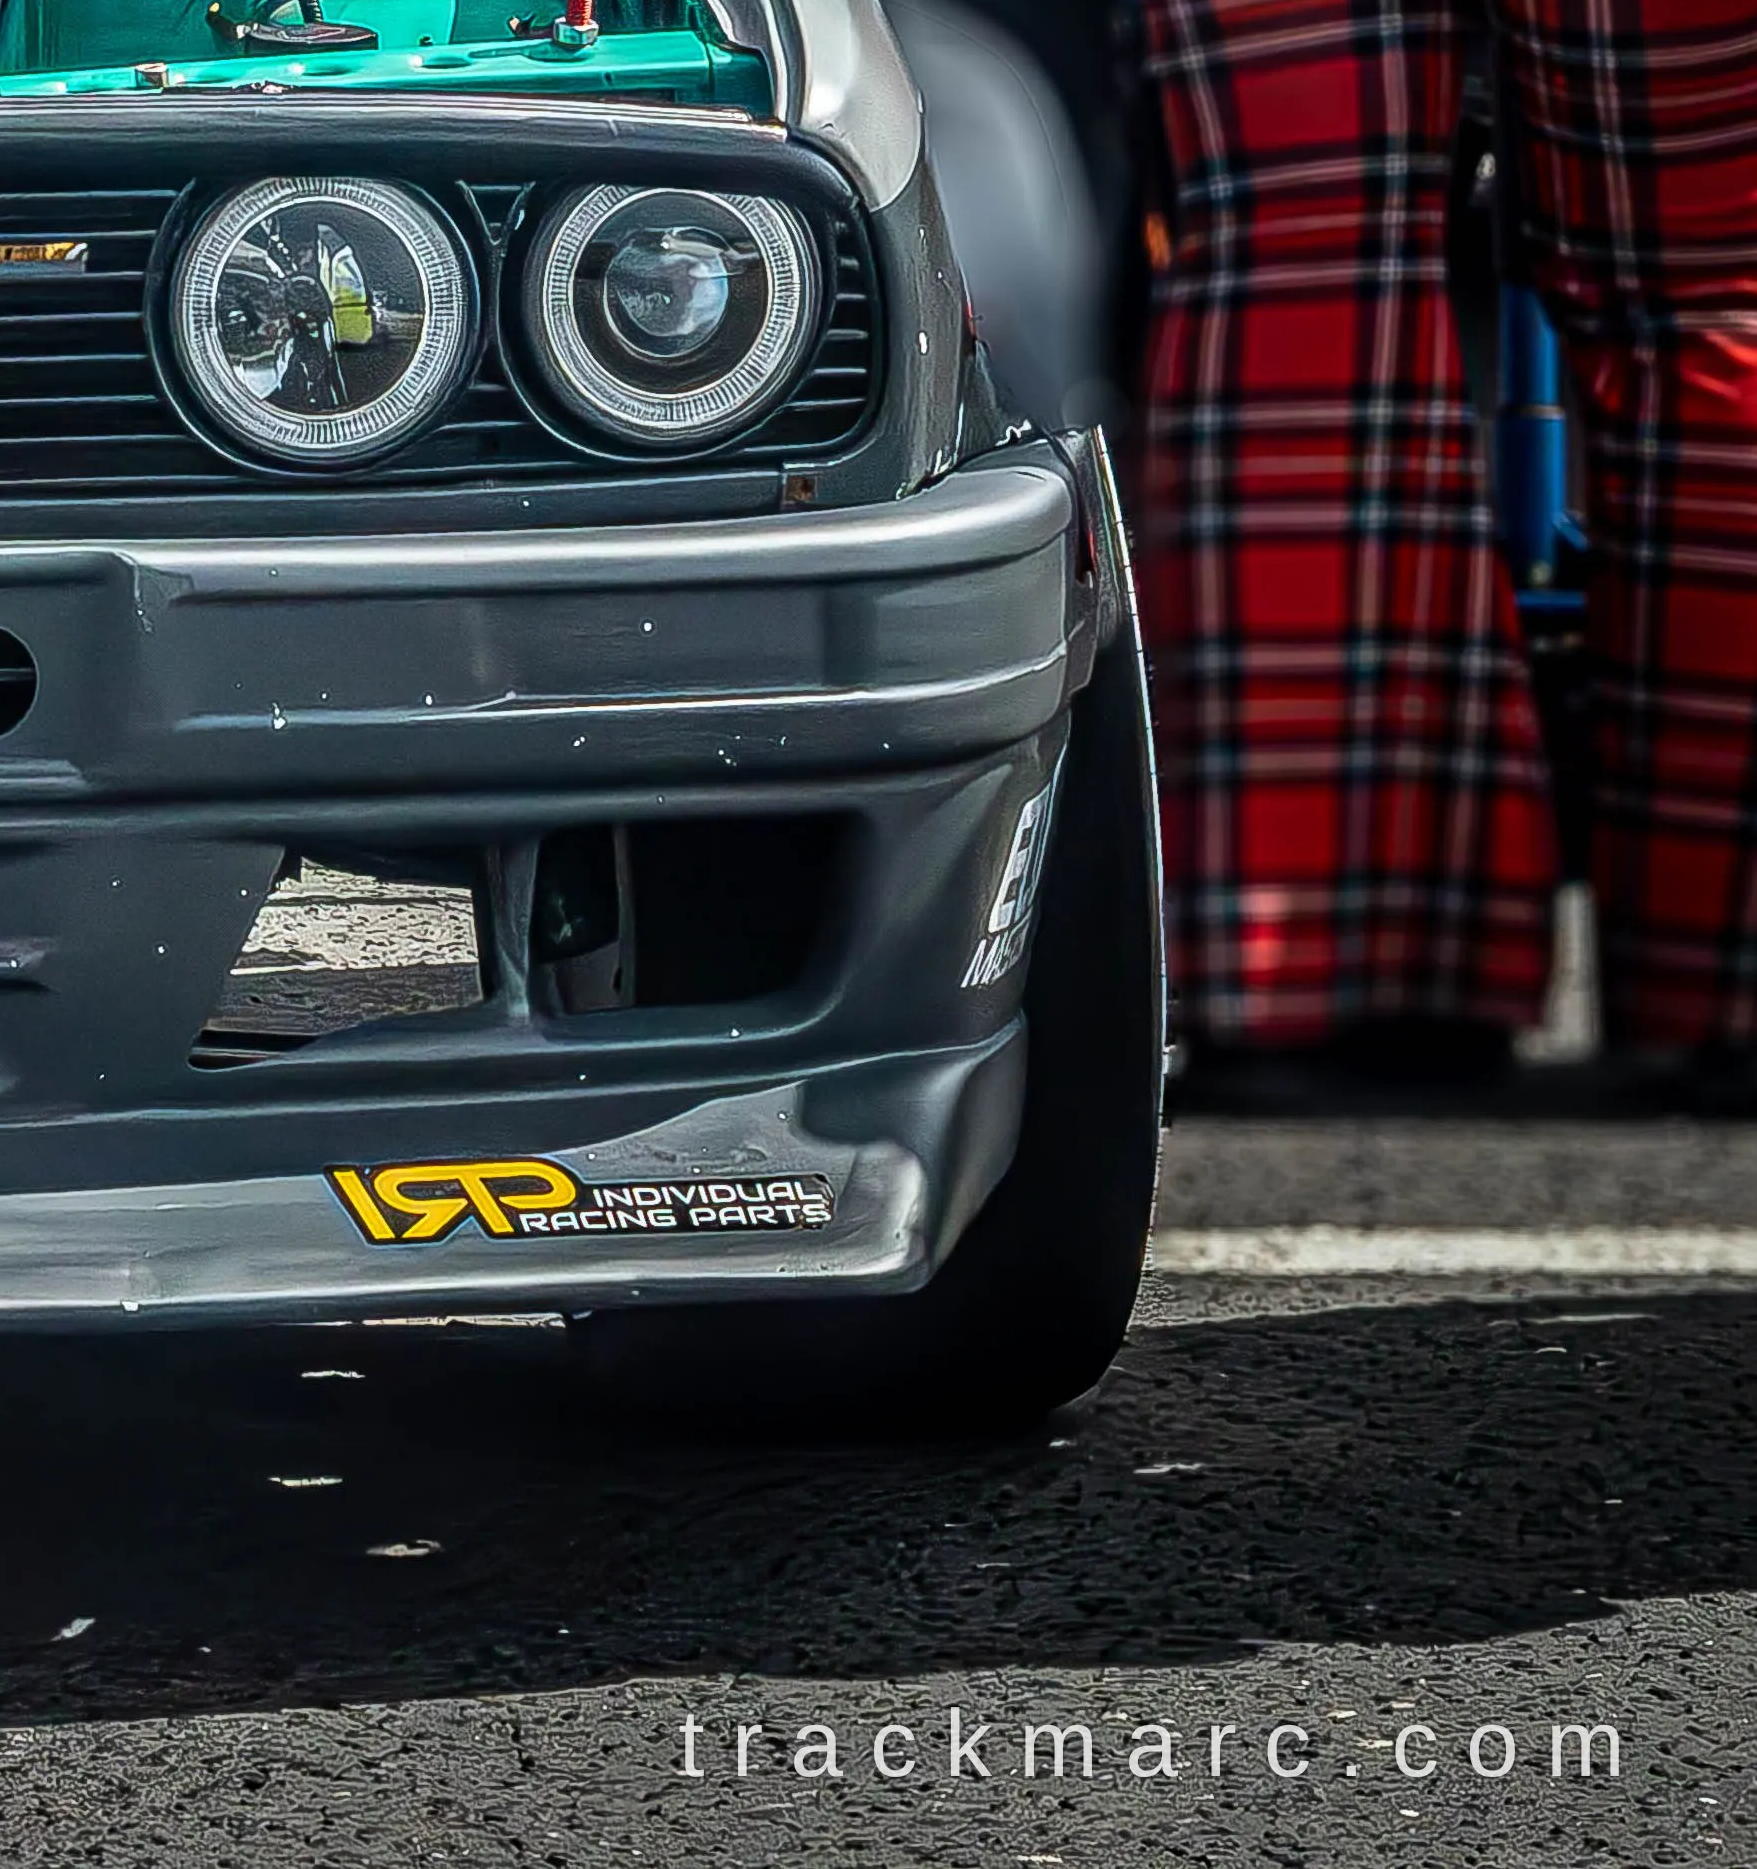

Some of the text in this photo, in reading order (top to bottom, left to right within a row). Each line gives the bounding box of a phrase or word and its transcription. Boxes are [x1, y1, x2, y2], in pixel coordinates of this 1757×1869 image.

[592, 1181, 824, 1209] INDIVIDUAL
[519, 1202, 833, 1234] RACING PARTS
